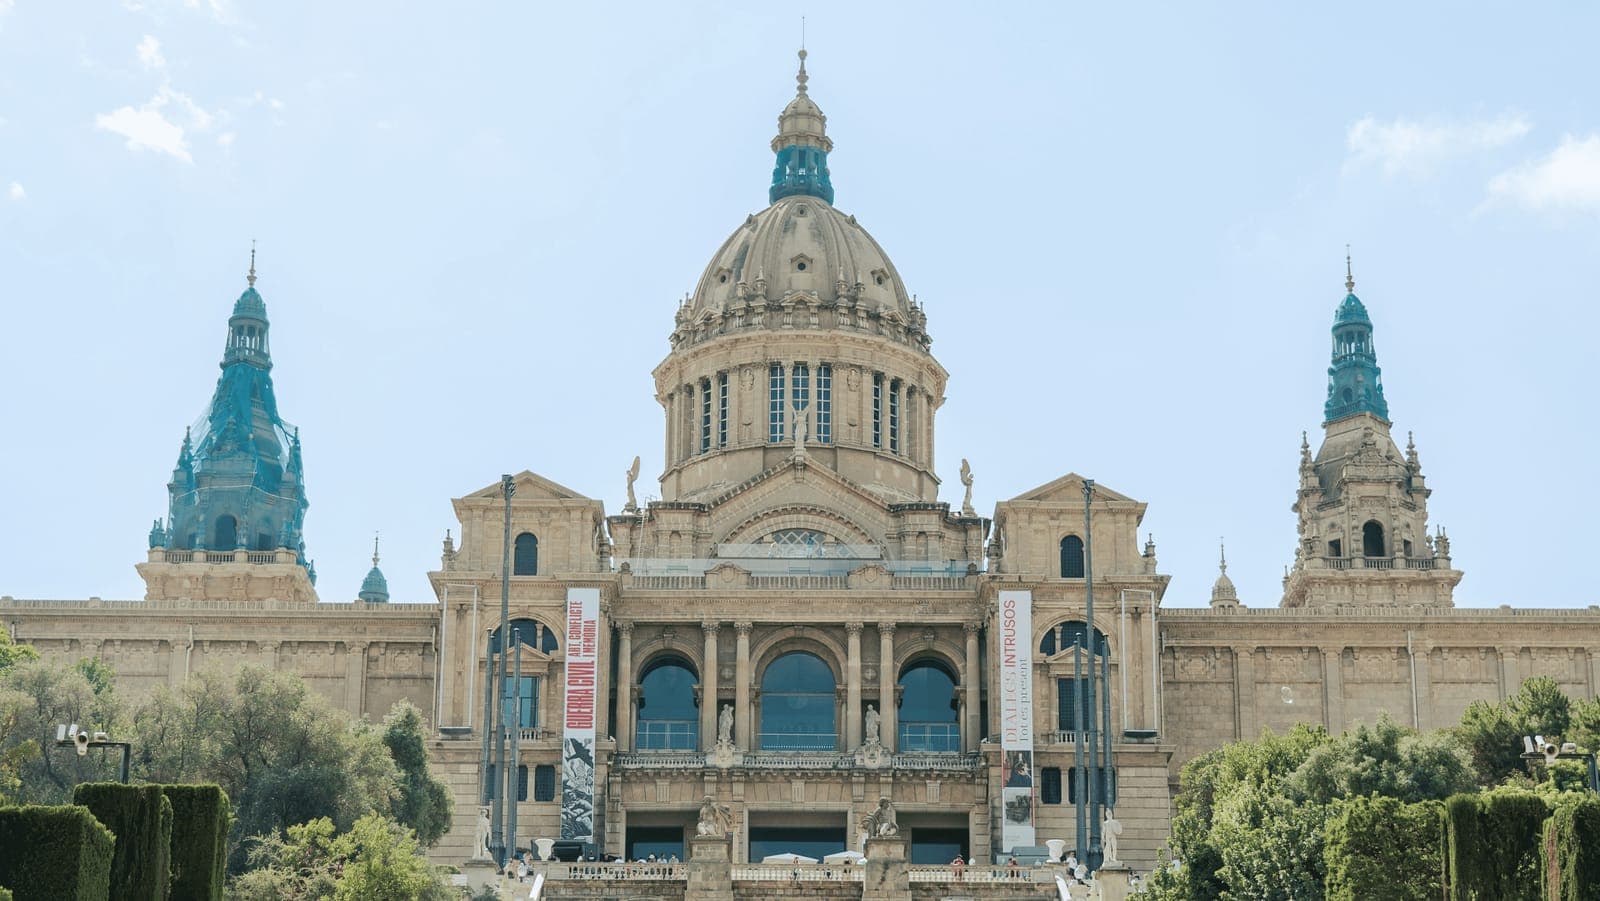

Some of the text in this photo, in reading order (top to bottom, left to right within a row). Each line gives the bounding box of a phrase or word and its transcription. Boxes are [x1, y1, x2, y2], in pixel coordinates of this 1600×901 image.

[569, 600, 583, 640] CONFLICTE
[1003, 600, 1016, 668] INTRUSOS
[566, 660, 595, 729] GUERRA CIVIL
[1019, 657, 1031, 704] present
